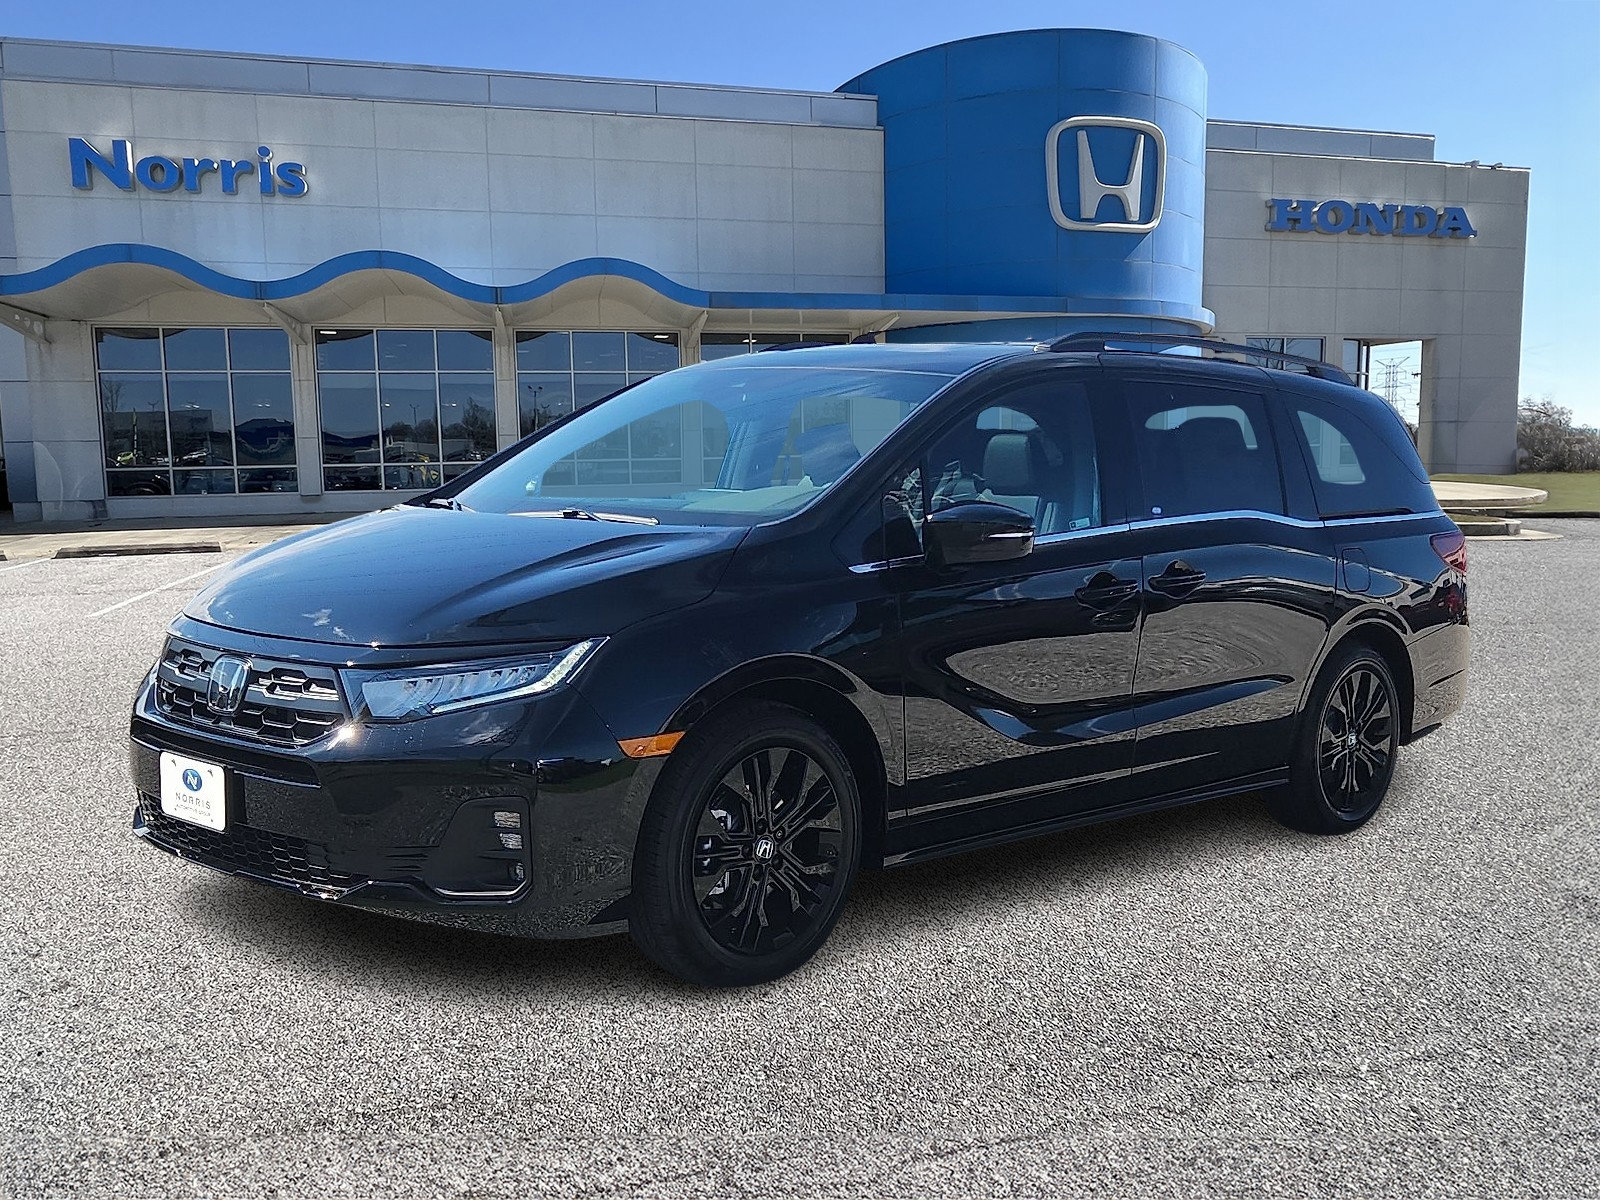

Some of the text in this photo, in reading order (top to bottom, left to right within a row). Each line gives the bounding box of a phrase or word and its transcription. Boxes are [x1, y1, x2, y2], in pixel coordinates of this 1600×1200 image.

[68, 137, 309, 197] Norris
[1265, 198, 1478, 239] HONDA
[175, 792, 211, 810] NORRIS
